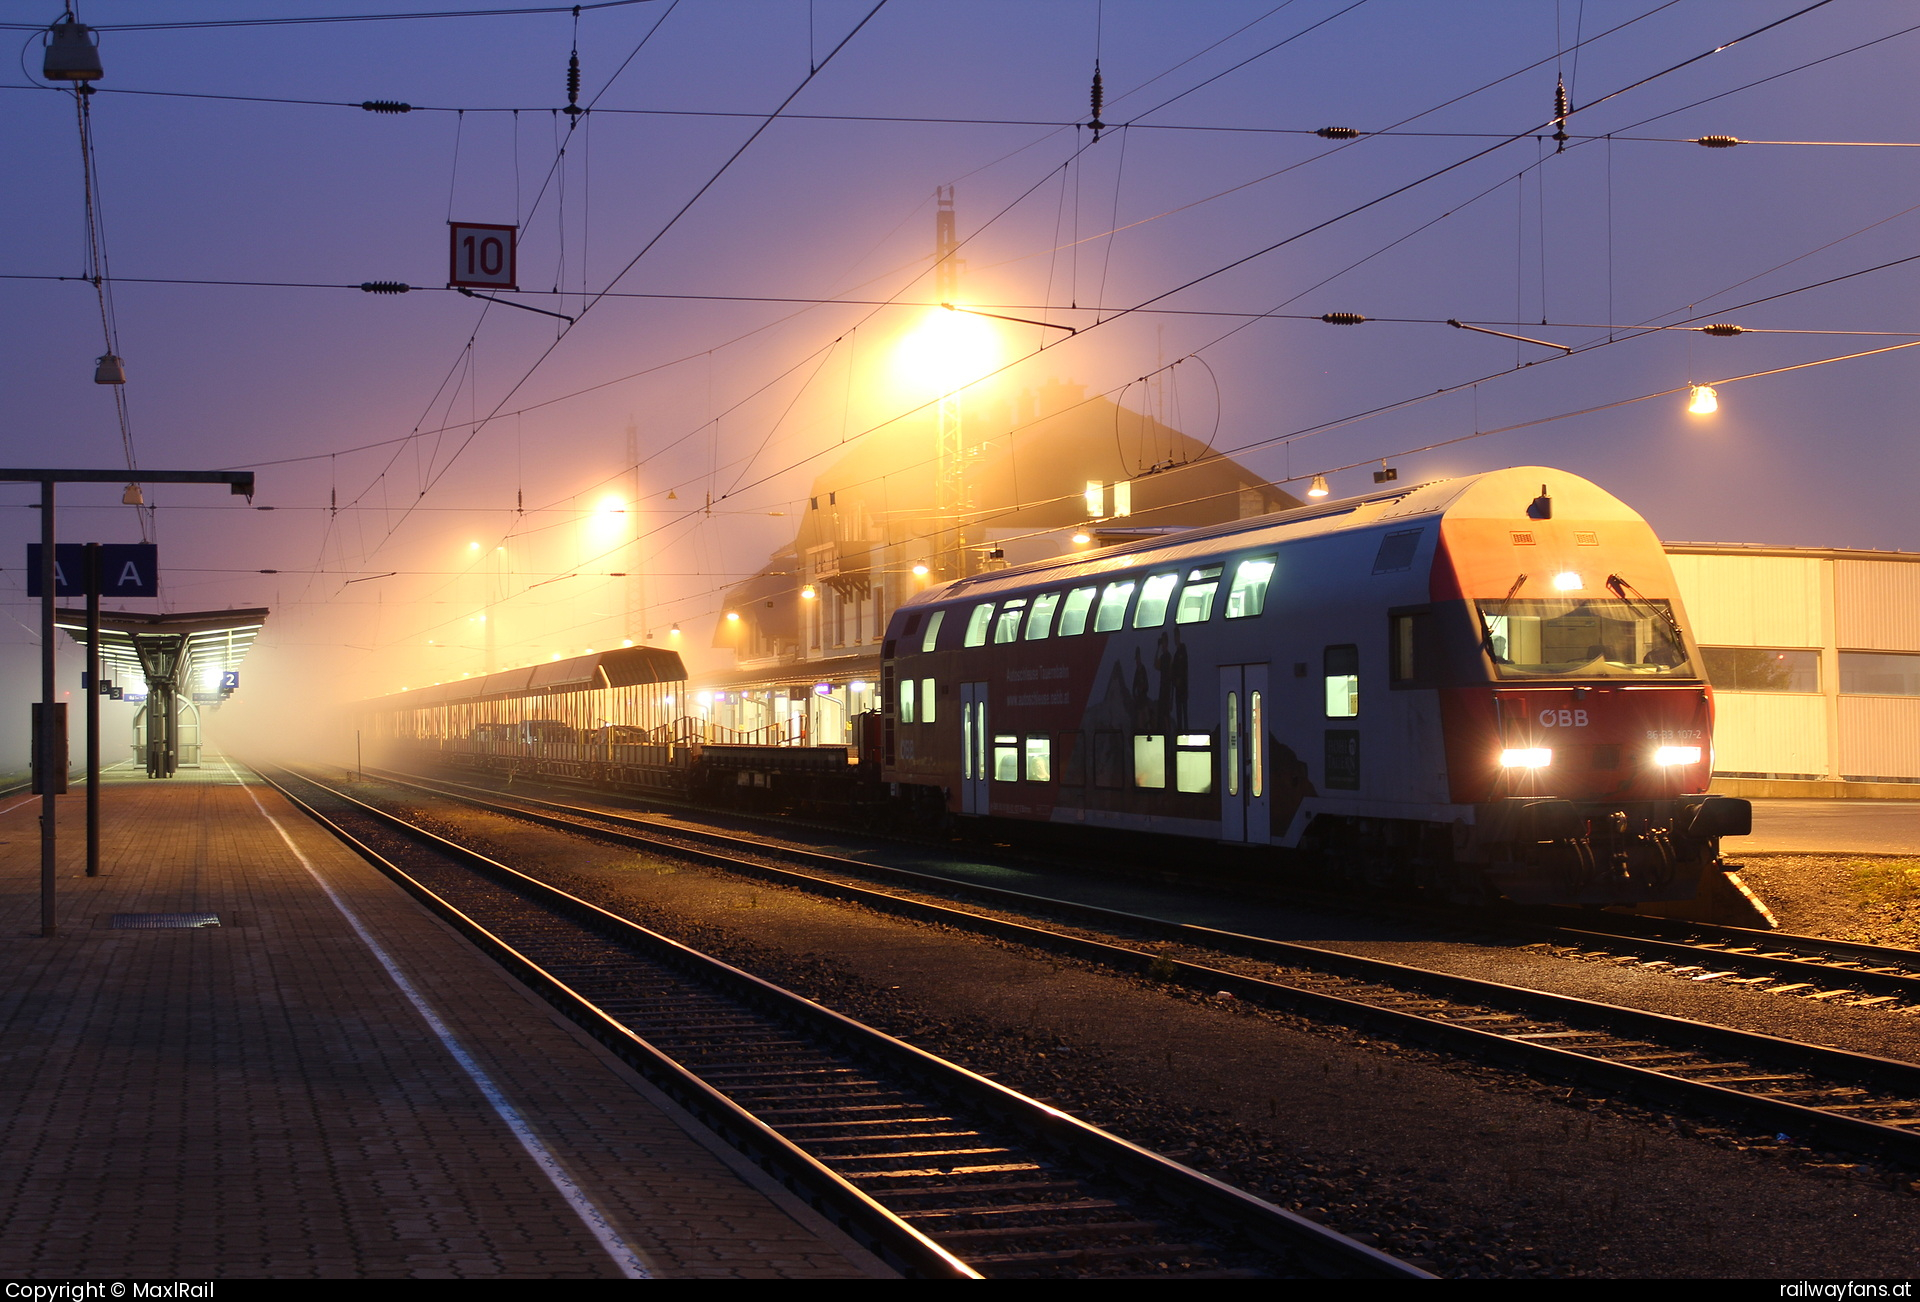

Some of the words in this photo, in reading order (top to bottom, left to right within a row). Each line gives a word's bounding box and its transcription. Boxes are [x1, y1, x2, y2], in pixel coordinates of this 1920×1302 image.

[463, 235, 503, 276] 10
[117, 561, 142, 586] A
[226, 674, 235, 686] 2
[113, 689, 120, 698] 3
[729, 694, 734, 703] 1
[1539, 709, 1589, 728] ÖBB
[1677, 729, 1702, 739] 107-2
